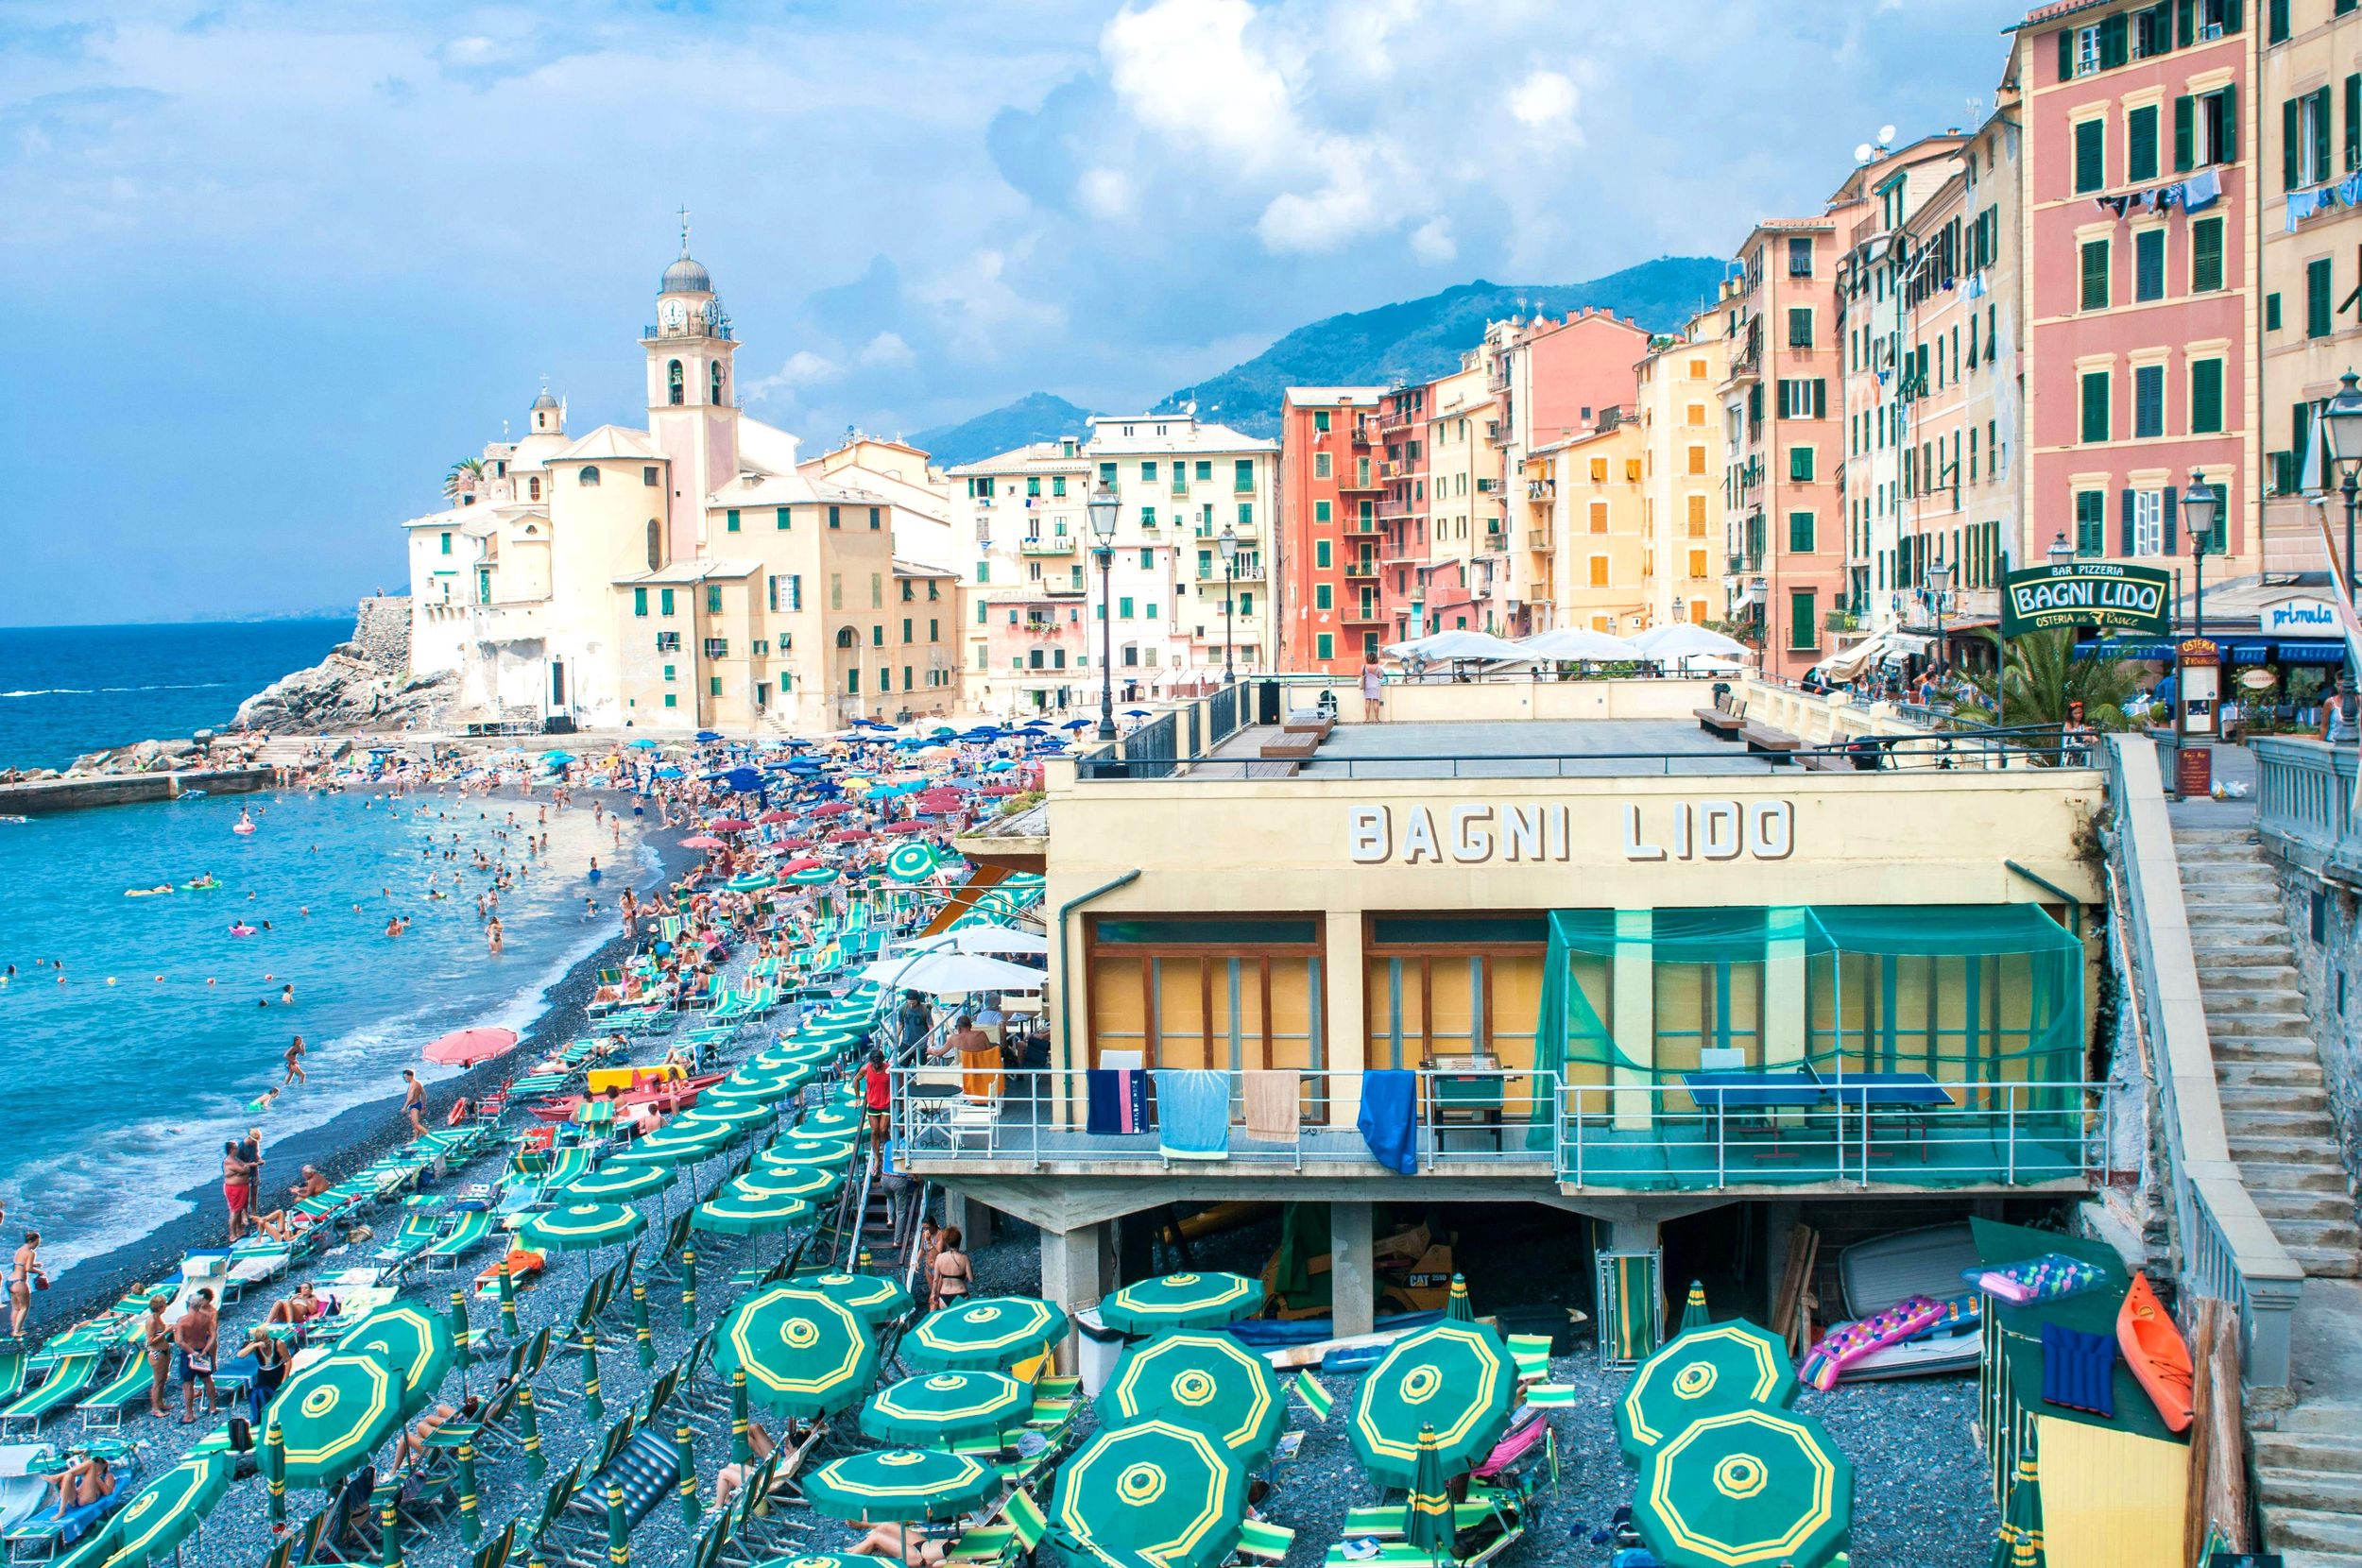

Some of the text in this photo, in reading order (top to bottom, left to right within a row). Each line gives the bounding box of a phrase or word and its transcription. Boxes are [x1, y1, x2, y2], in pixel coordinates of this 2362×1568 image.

[2052, 565, 2124, 576] BAR PIZZERIA
[2016, 581, 2157, 612] BAGNI LIDO
[2036, 613, 2075, 627] OSTERIA
[2273, 602, 2333, 629] primula
[2182, 639, 2216, 652] OSTERIA
[1348, 799, 1795, 864] BAGNI LIDO
[1410, 1274, 1429, 1287] CAT
